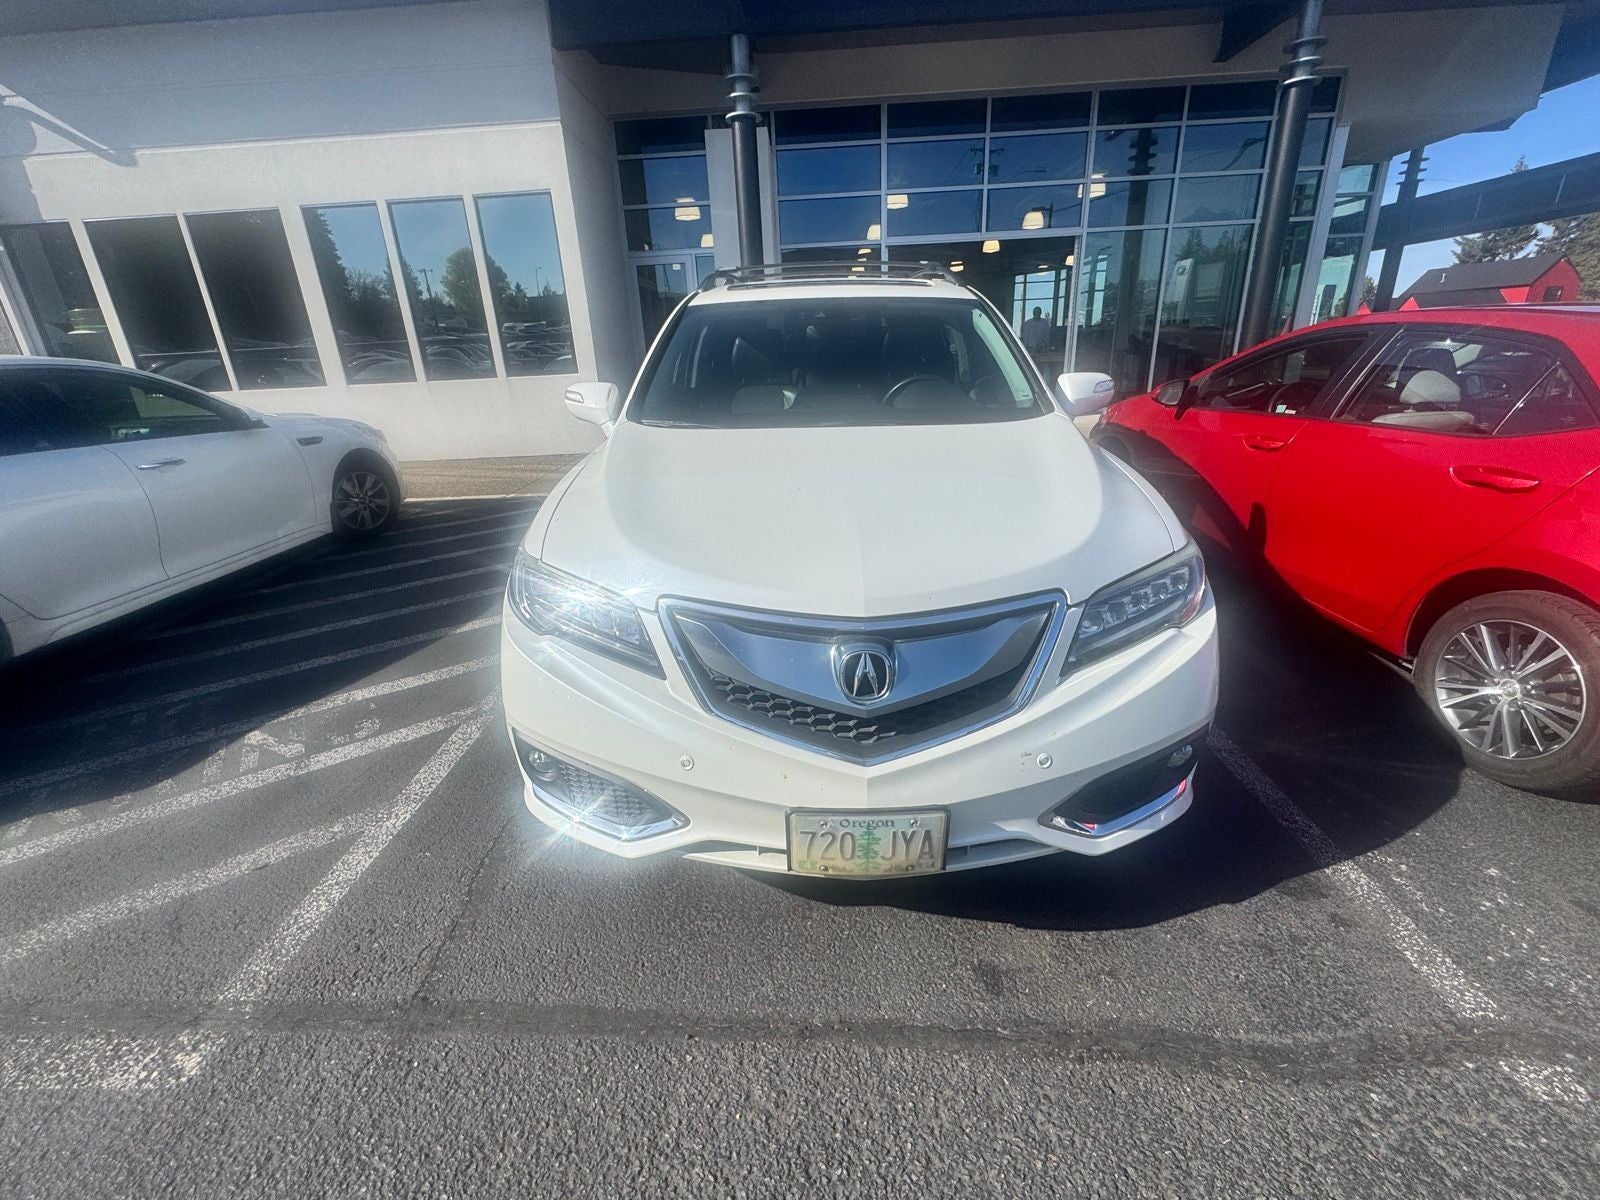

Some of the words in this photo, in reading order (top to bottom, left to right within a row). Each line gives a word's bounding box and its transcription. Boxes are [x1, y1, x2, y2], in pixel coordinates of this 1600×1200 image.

[839, 818, 895, 830] Oregon
[800, 831, 856, 861] 720
[880, 830, 935, 861] JYA
